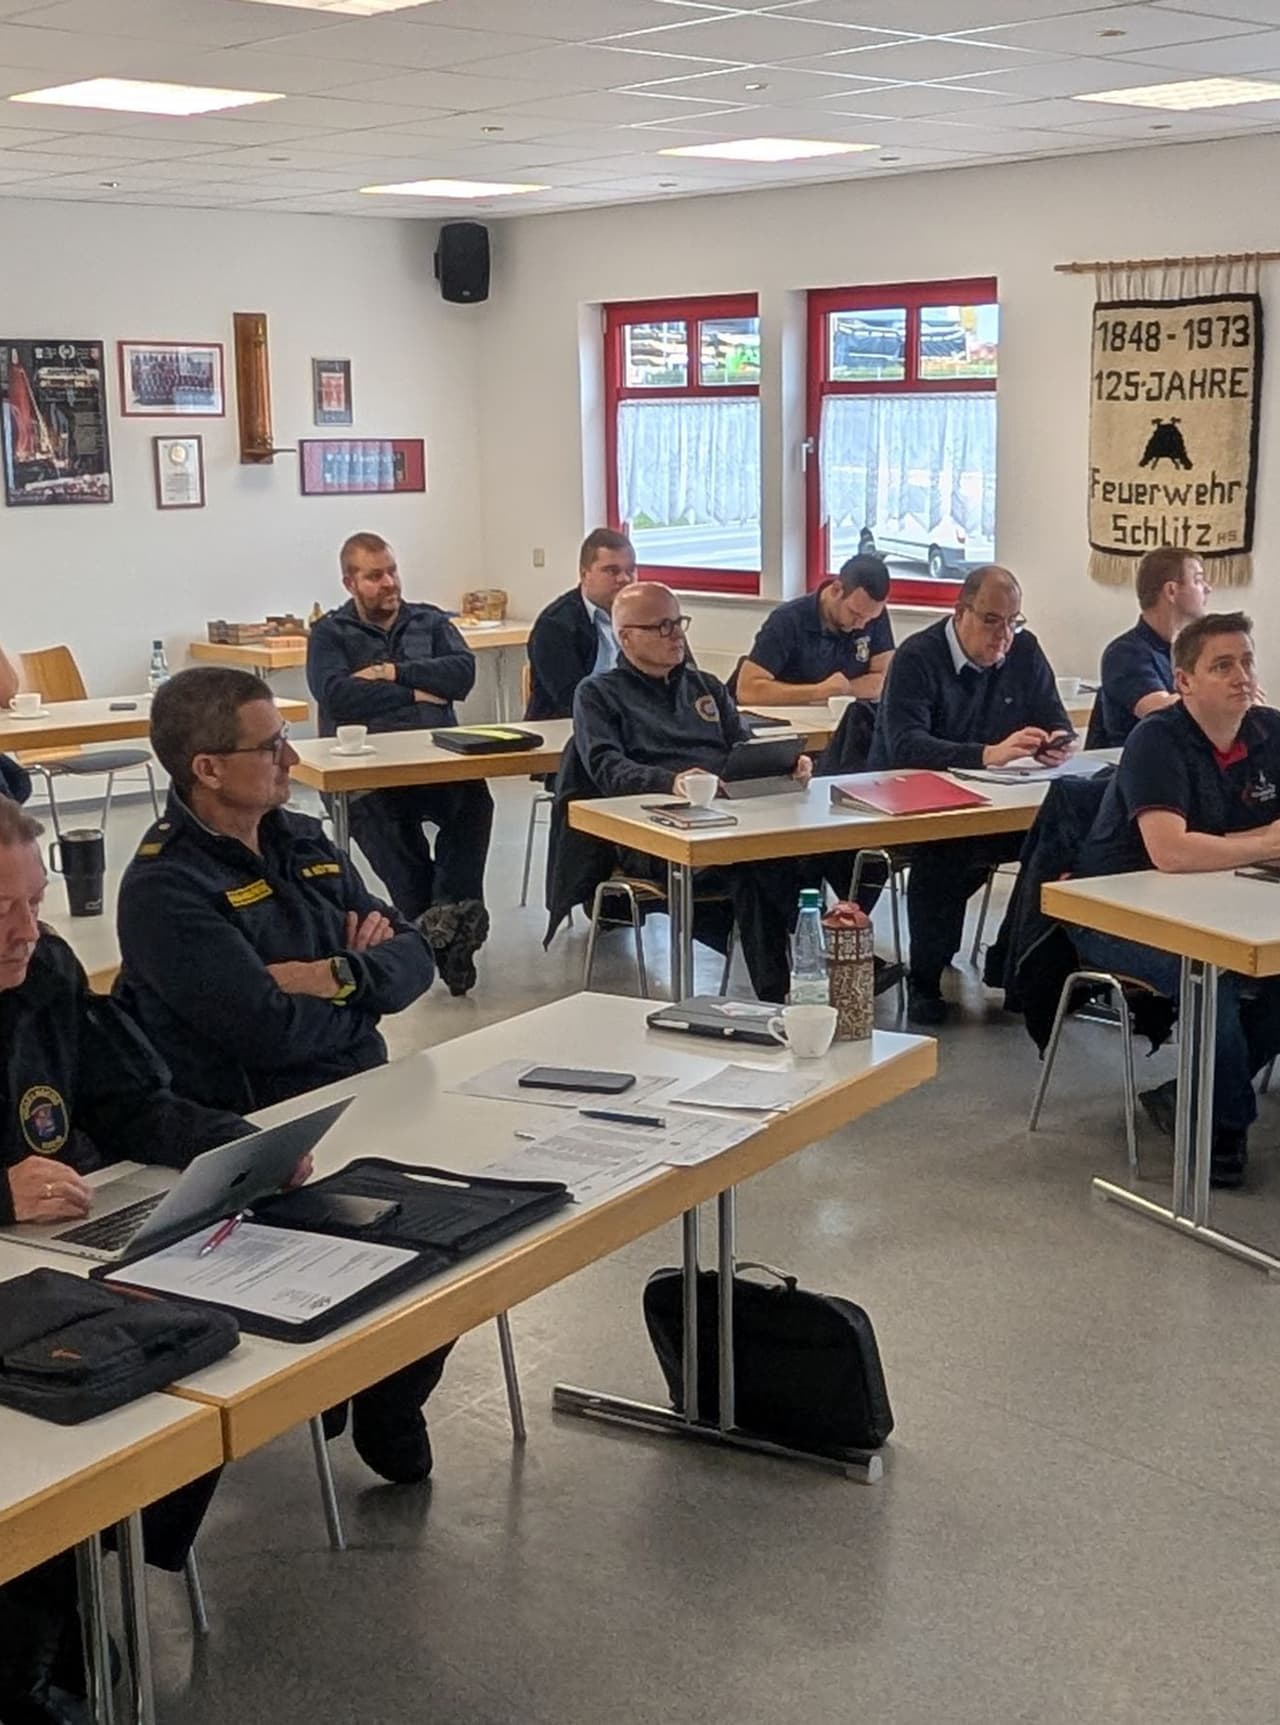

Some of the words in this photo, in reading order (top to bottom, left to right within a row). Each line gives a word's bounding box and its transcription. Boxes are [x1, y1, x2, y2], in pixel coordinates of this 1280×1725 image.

[1096, 320, 1161, 352] 1848
[1183, 314, 1250, 351] 1973
[1091, 467, 1241, 506] Feuerwehr
[1112, 514, 1212, 547] Schlitz
